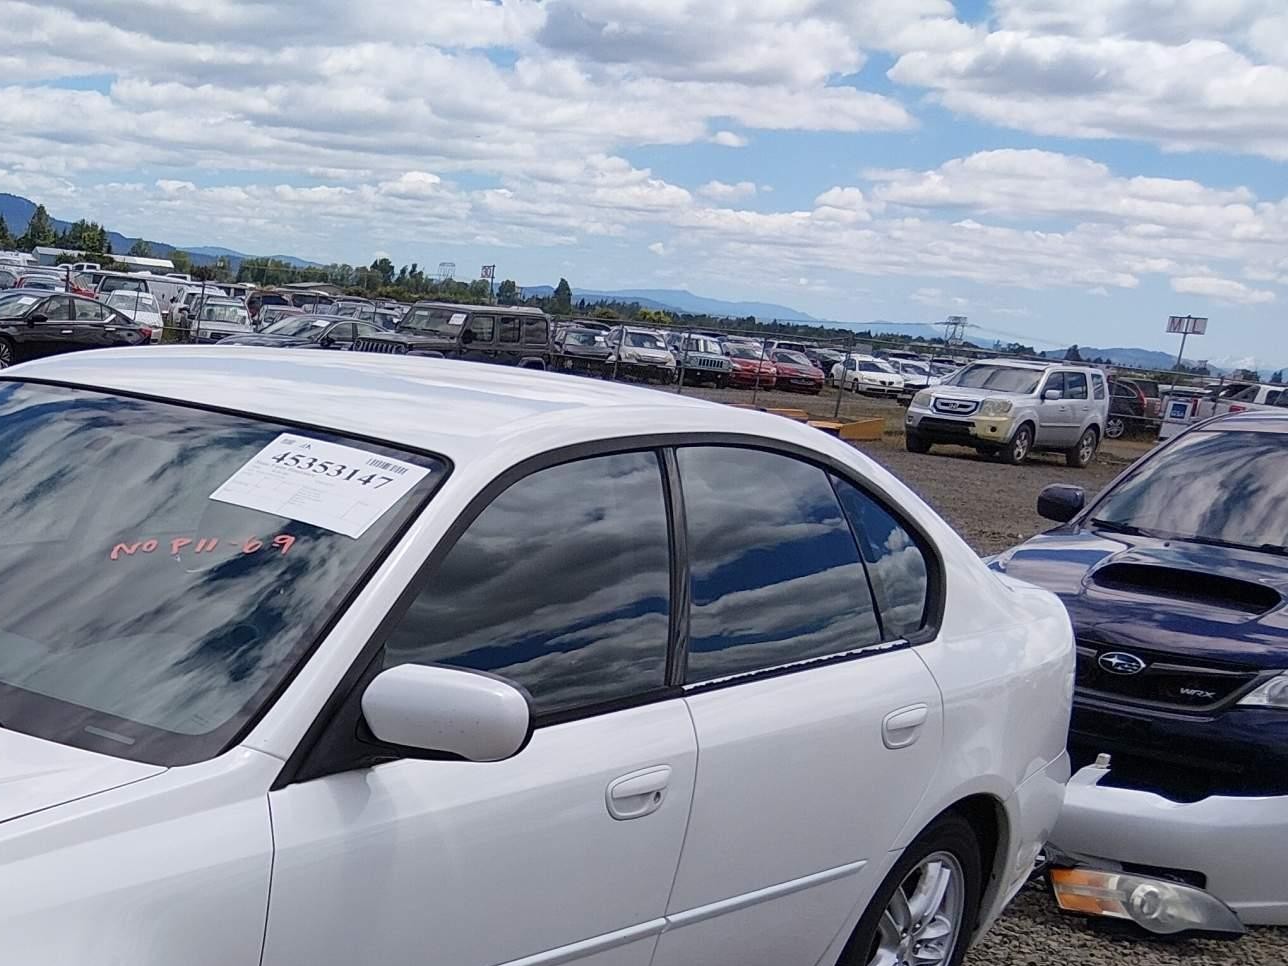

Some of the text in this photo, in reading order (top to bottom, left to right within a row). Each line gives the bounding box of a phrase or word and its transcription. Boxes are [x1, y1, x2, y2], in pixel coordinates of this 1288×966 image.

[271, 451, 394, 489] 45353147
[110, 538, 159, 560] NO
[1180, 687, 1216, 698] WRX
